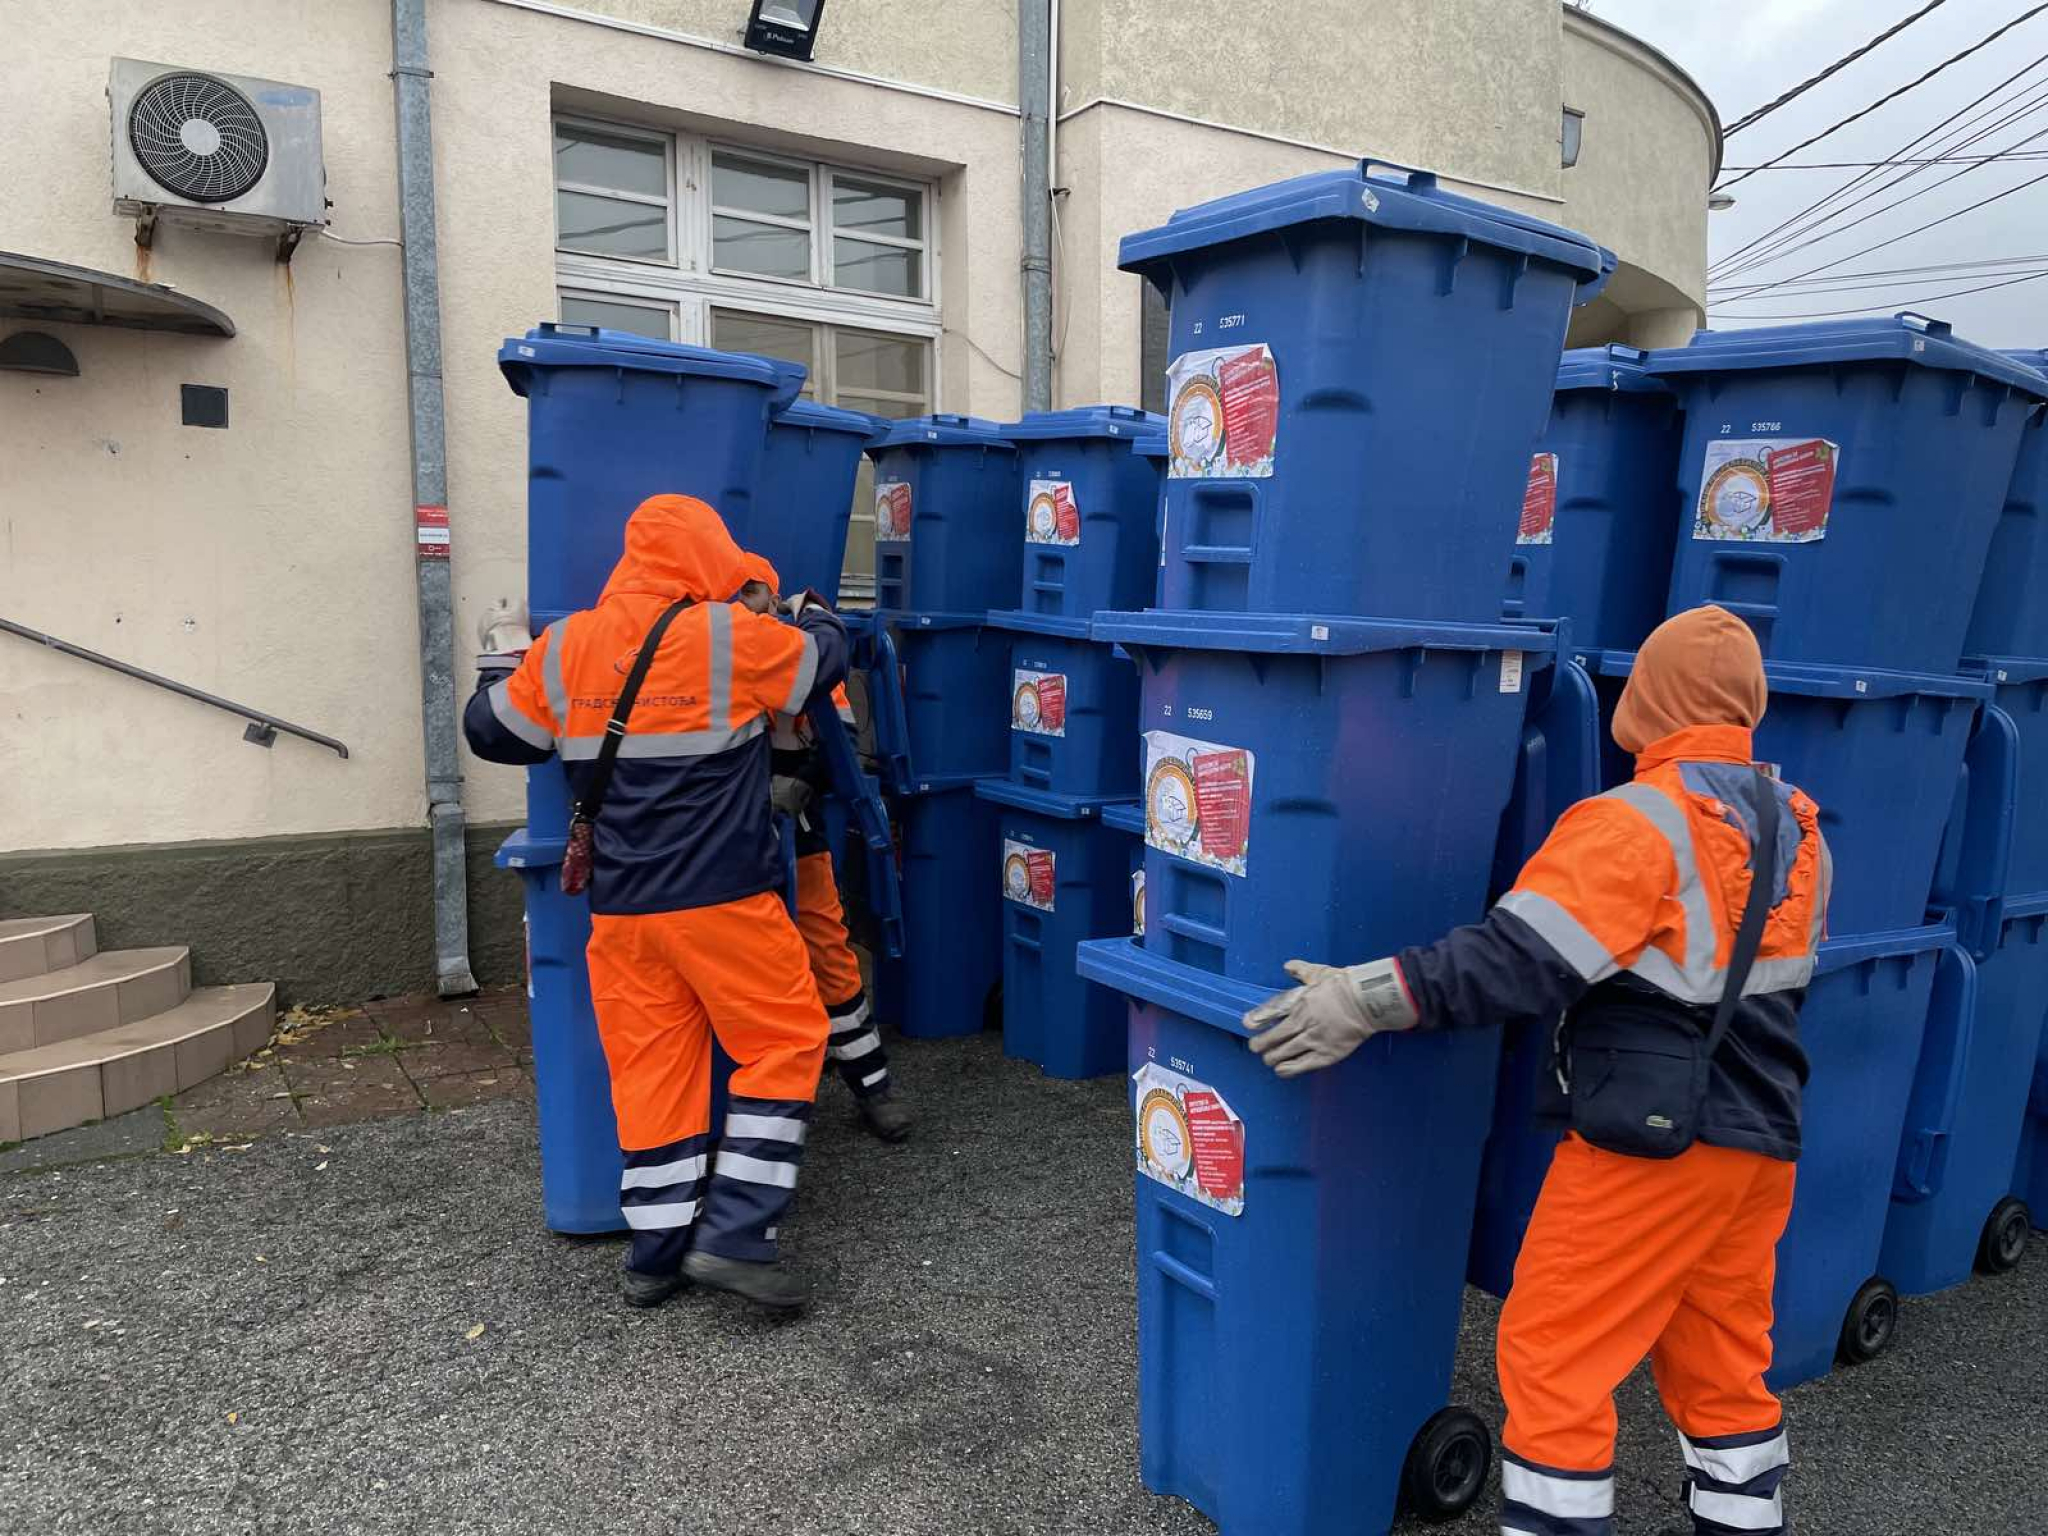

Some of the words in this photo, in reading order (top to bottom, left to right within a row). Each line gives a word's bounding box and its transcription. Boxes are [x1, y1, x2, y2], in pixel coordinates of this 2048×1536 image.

[1193, 322, 1203, 334] 22
[1720, 424, 1731, 434] 22
[1164, 704, 1172, 716] 22
